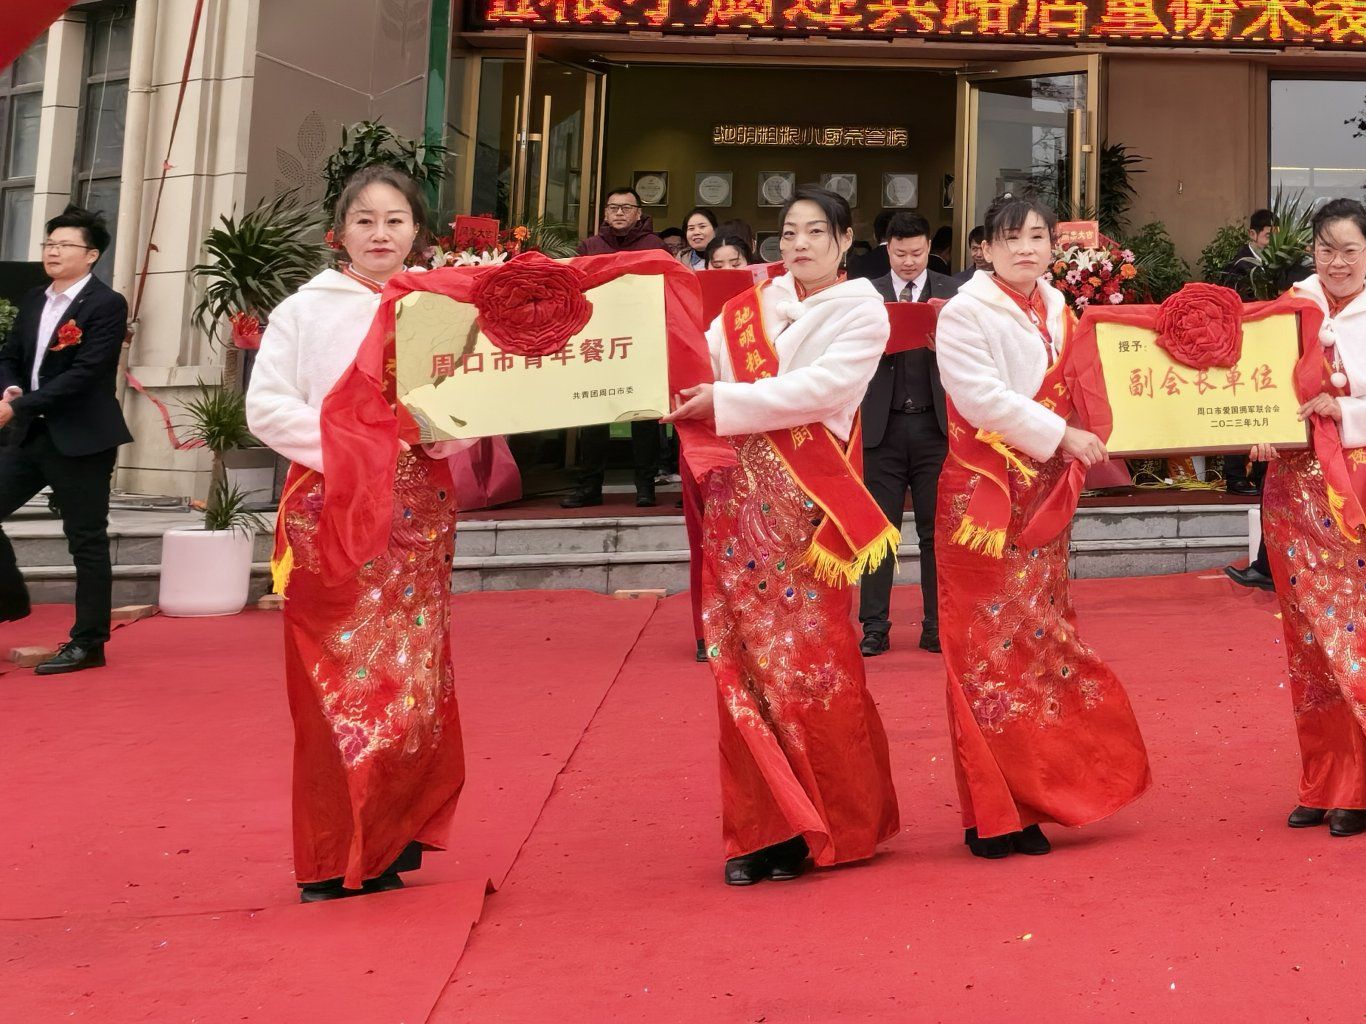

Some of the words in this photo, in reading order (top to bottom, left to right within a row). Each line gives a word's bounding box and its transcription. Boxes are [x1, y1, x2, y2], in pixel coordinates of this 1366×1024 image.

[1129, 364, 1278, 399] 副会长单位
[572, 386, 634, 400] 共青团周口市委
[1197, 404, 1280, 416] 周口市爱国拥军联合会
